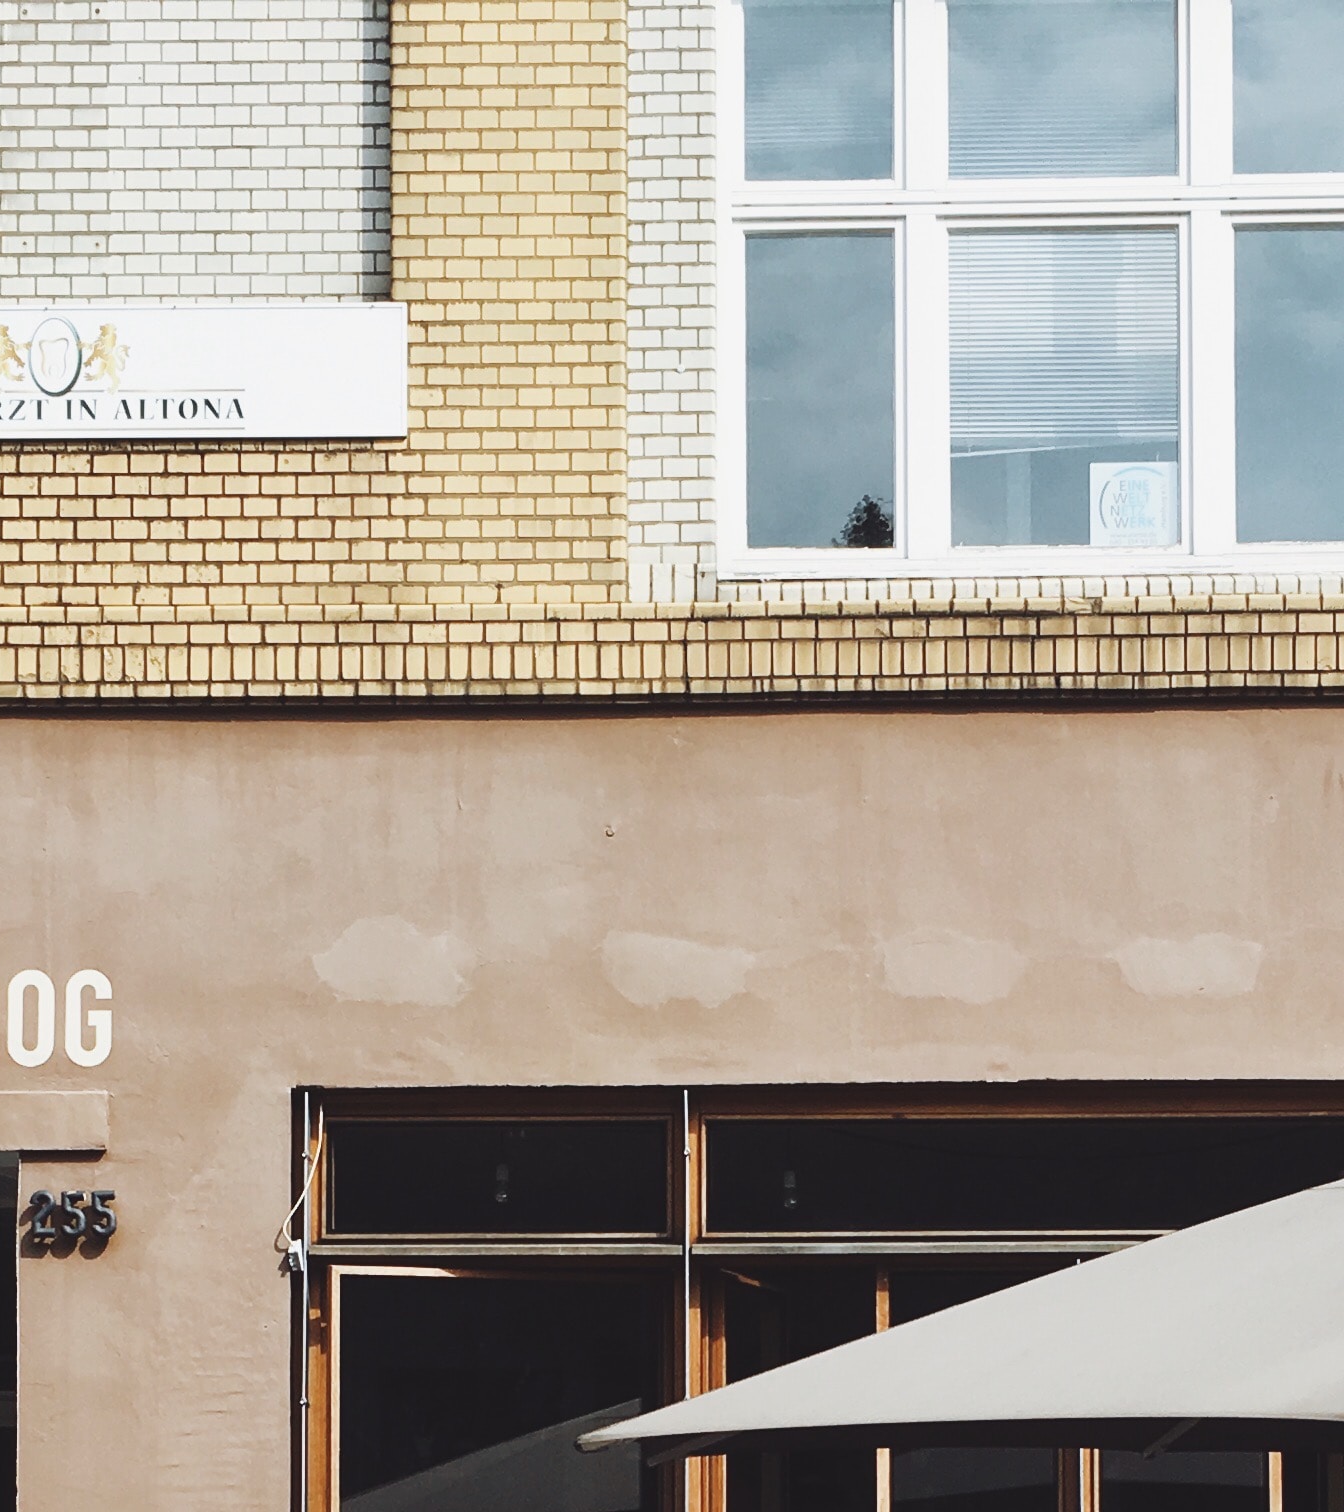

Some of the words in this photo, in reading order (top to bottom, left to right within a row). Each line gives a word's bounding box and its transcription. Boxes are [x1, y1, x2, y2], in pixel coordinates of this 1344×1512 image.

[65, 397, 99, 420] IN
[113, 397, 247, 420] ALTONA
[1120, 480, 1149, 491] EINE
[1113, 492, 1149, 504] WELT
[1114, 517, 1156, 528] WERK
[30, 1190, 117, 1238] 255
